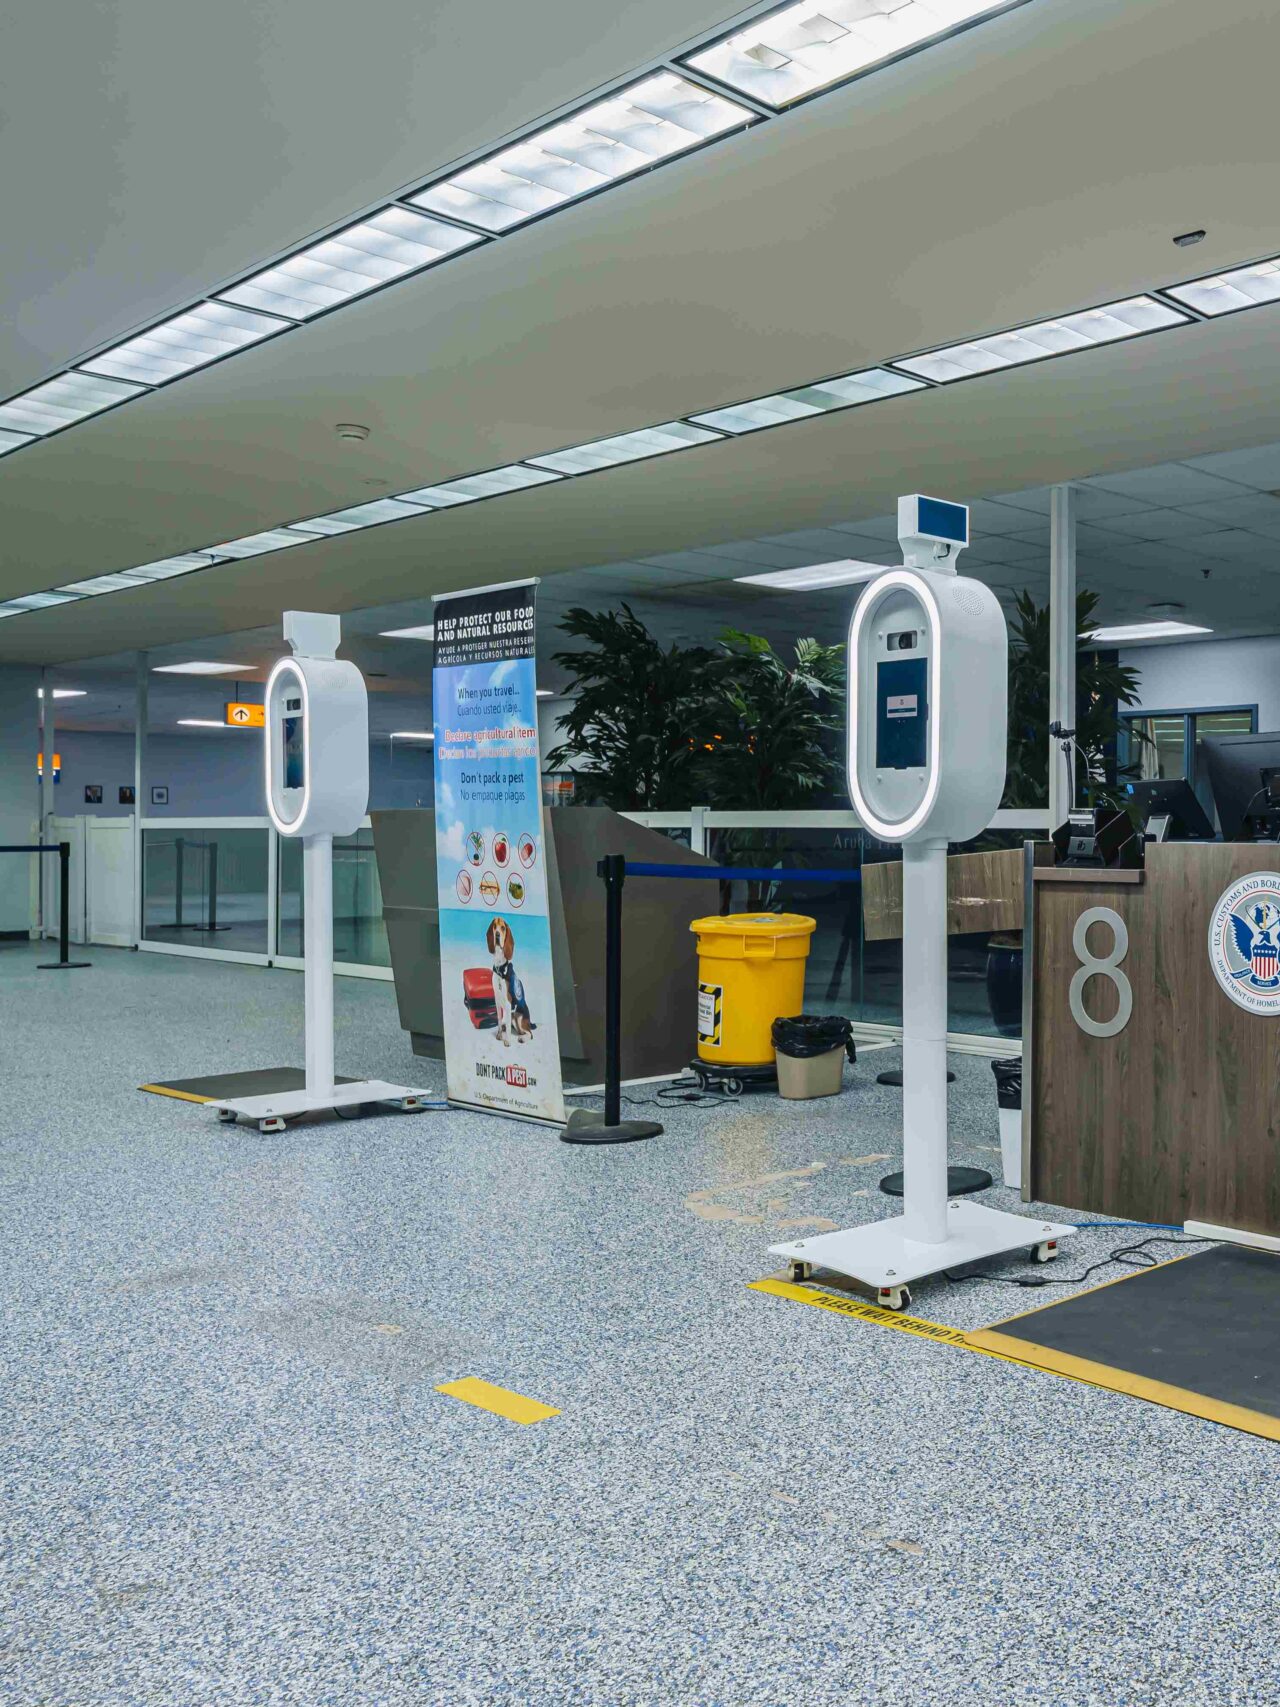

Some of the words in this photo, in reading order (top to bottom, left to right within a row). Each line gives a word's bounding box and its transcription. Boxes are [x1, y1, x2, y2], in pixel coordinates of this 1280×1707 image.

[437, 618, 457, 630] HELP
[460, 613, 492, 627] PROTECT
[495, 609, 511, 622] OUR
[514, 606, 534, 619] FOOD
[437, 630, 455, 641] AND
[457, 624, 490, 639] NATURAL
[493, 618, 533, 634] RESOURCES
[462, 641, 487, 651] PROTEGER
[489, 639, 512, 648] NUESTRA
[475, 650, 502, 660] RECURSOS
[458, 688, 478, 699] When
[480, 688, 492, 700] you
[457, 703, 481, 716] Cuando
[483, 702, 501, 715] usted
[474, 726, 515, 743] agricultural
[461, 772, 482, 784] Don't
[483, 771, 500, 786] pack
[503, 774, 506, 783] a
[508, 772, 524, 786] pest
[460, 790, 469, 801] No
[472, 790, 503, 804] empaque
[504, 788, 525, 804] plagas
[1242, 881, 1259, 893] AND
[1217, 888, 1243, 928] CUSTOMS
[1214, 929, 1222, 946] U.S.
[1069, 906, 1132, 1037] 8
[1217, 960, 1246, 999] DEPARTMENT
[1247, 993, 1256, 1004] OF
[491, 1065, 506, 1081] PACK
[482, 1093, 508, 1104] Department
[514, 1100, 538, 1110] Agriculture
[812, 1296, 862, 1312] PLEASE
[858, 1308, 901, 1323] WAIT
[892, 1318, 953, 1340] BEHIND
